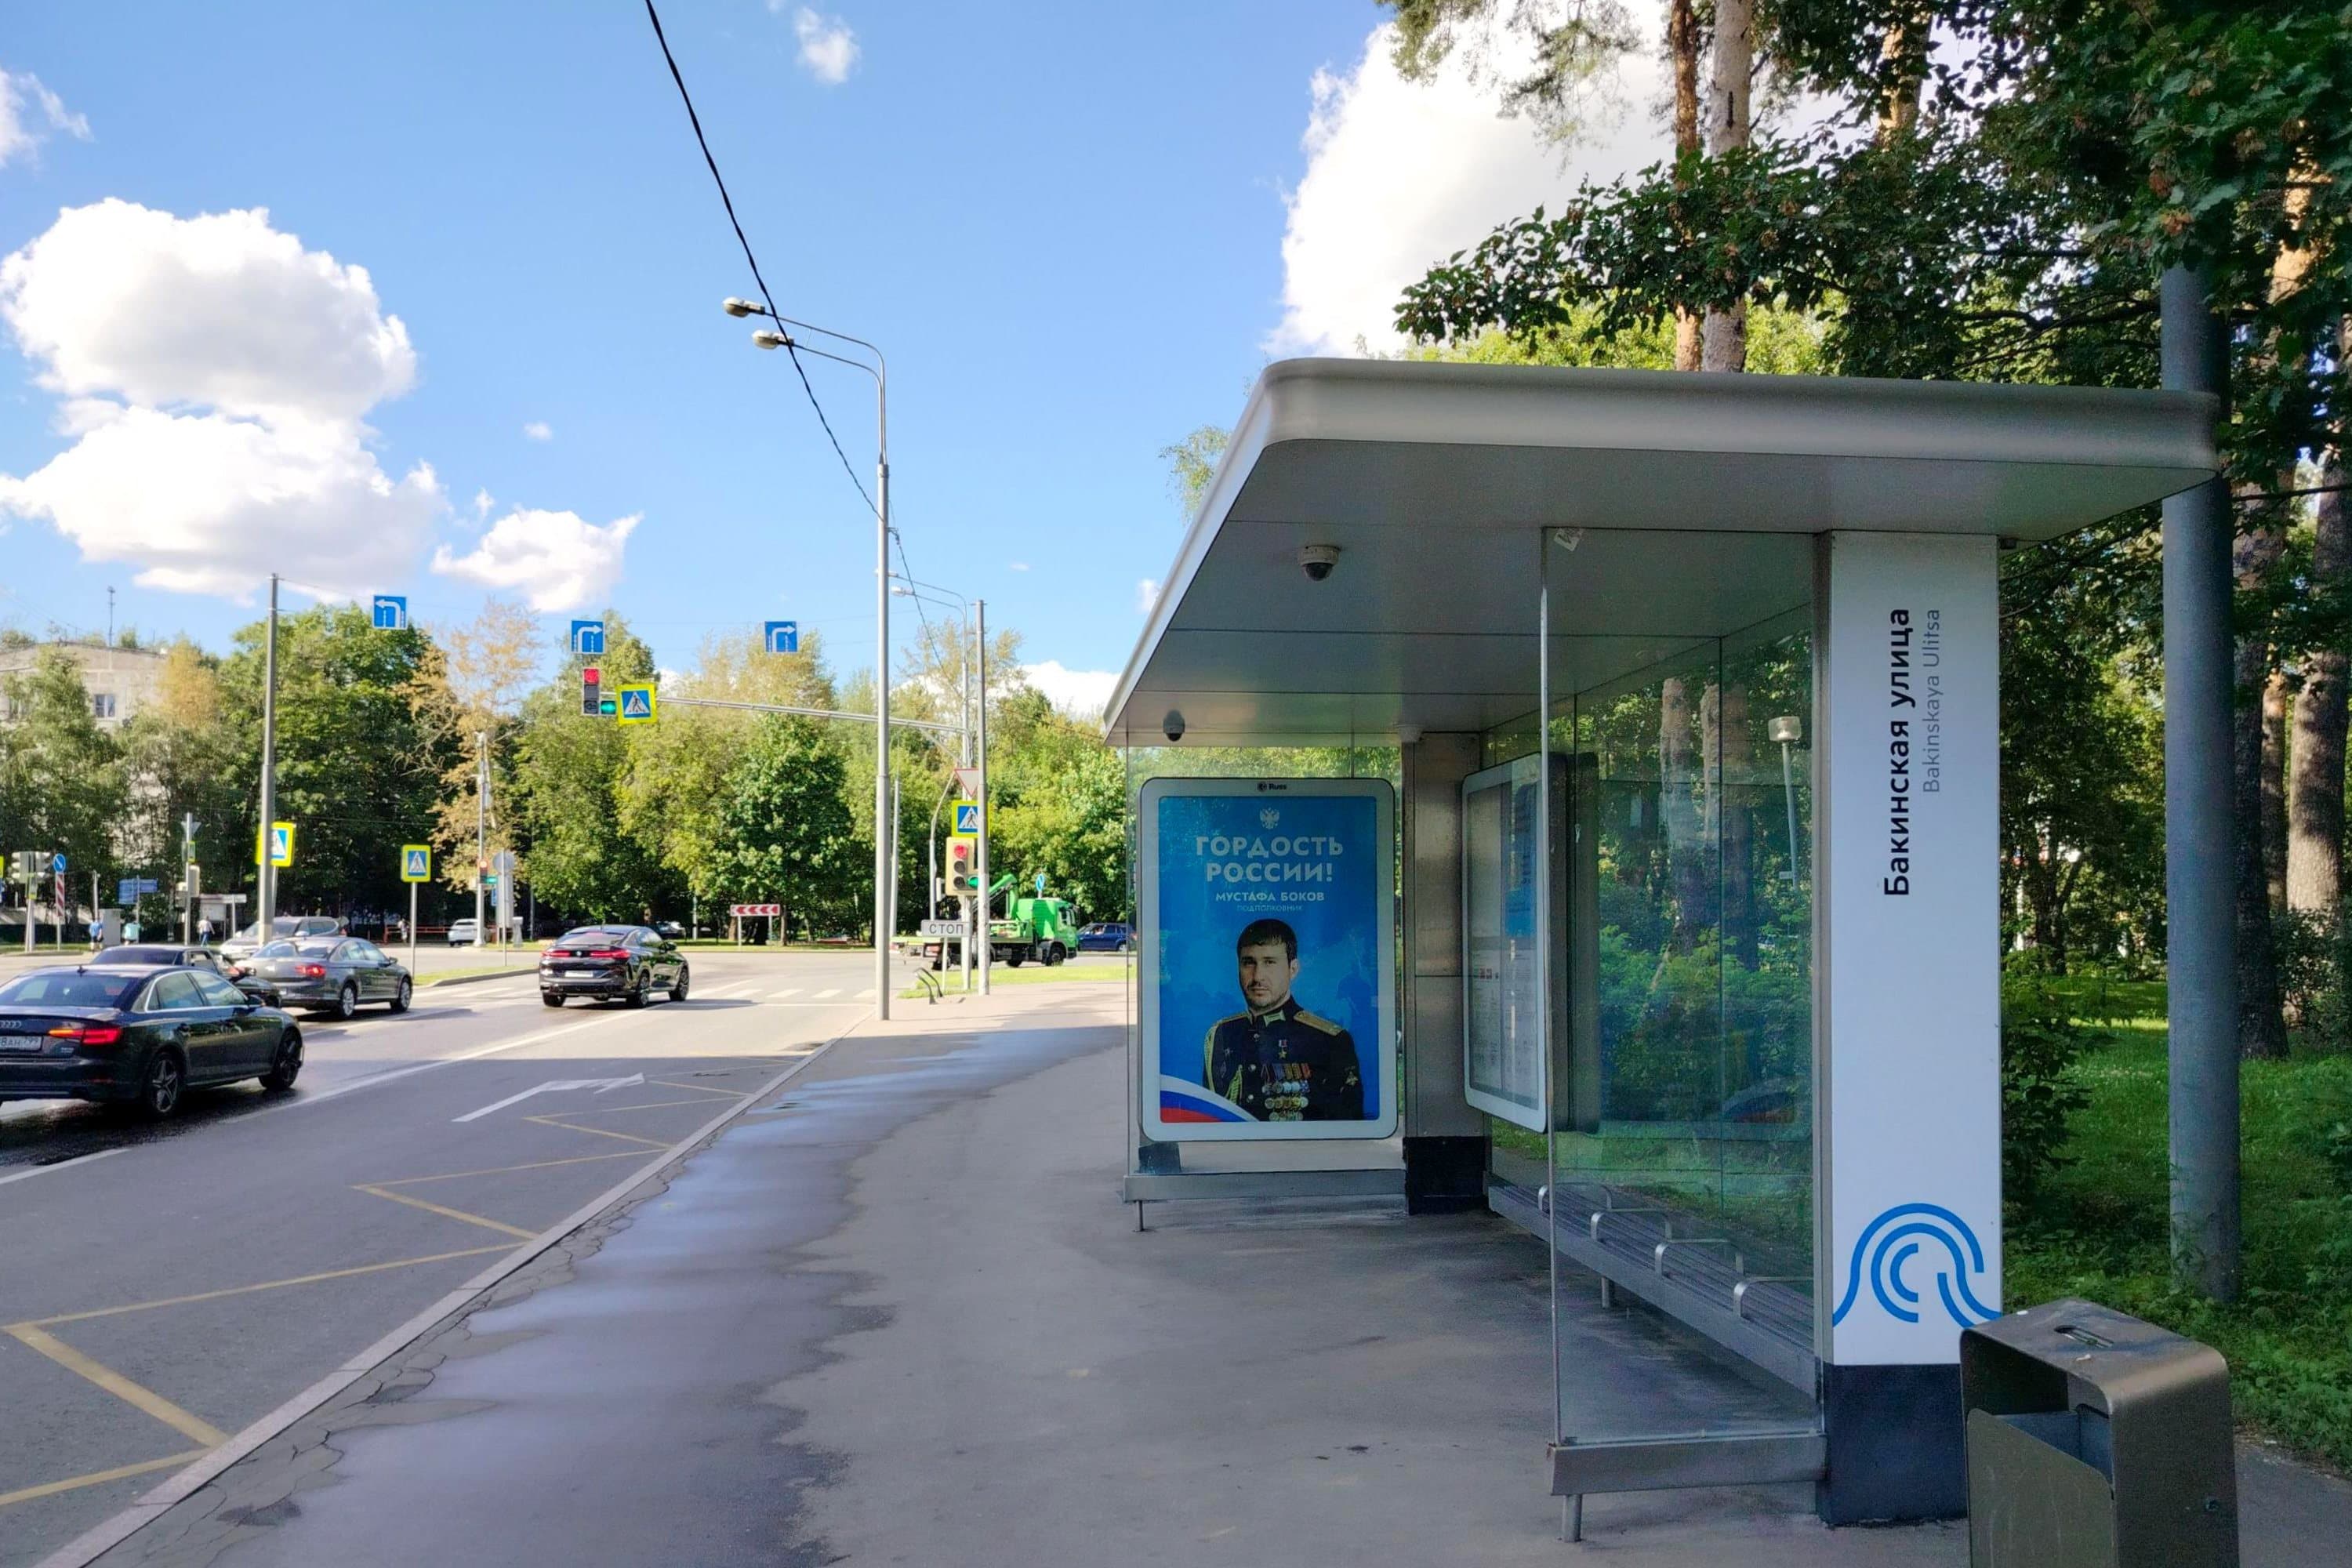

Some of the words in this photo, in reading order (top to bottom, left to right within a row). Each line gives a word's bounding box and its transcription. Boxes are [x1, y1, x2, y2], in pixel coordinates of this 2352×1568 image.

[1922, 608, 1940, 668] Ulitsa
[1890, 608, 1916, 708] улица
[1922, 674, 1944, 794] Bakinskaya
[1883, 720, 1910, 896] Бакинская
[1196, 836, 1344, 858] ГОРДОСТЬ
[1207, 862, 1333, 883] РОССИИ!
[1215, 891, 1276, 902] МУСТАФА
[1280, 891, 1325, 902] БОКОВ
[1236, 904, 1303, 913] ПОДПОЛКОВНИК
[929, 924, 964, 935] СТОП
